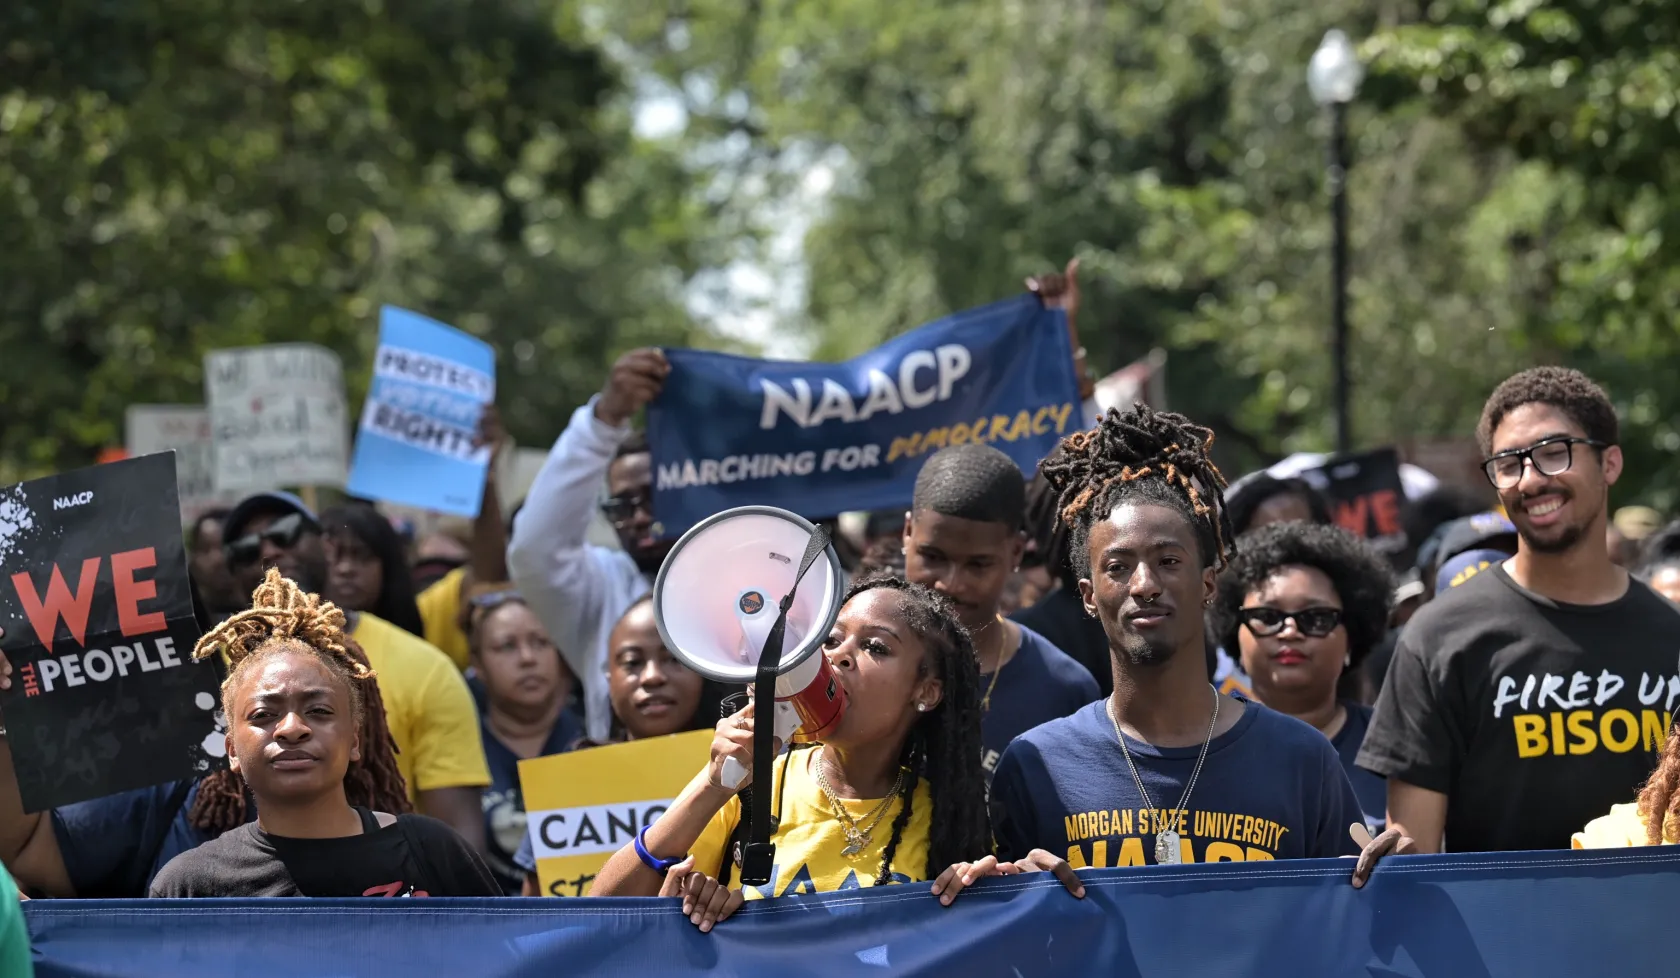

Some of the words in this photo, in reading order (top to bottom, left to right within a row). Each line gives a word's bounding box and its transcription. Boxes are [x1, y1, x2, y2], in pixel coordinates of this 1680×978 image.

[381, 349, 490, 391] PROTECT
[759, 343, 972, 429] NAACP
[657, 448, 816, 491] MARCHING
[821, 444, 881, 473] FOR
[886, 403, 1075, 464] DEMOCRACY
[53, 491, 94, 510] NAACP
[1329, 489, 1403, 538] WE
[11, 547, 168, 654] WE
[20, 662, 40, 698] THE
[37, 636, 182, 693] PEOPLE
[1493, 669, 1625, 718] FIRED
[1513, 708, 1672, 759] BISON
[1064, 809, 1133, 842] MORGAN
[1138, 808, 1188, 835] STATE
[1194, 810, 1287, 851] UNIVERSITY
